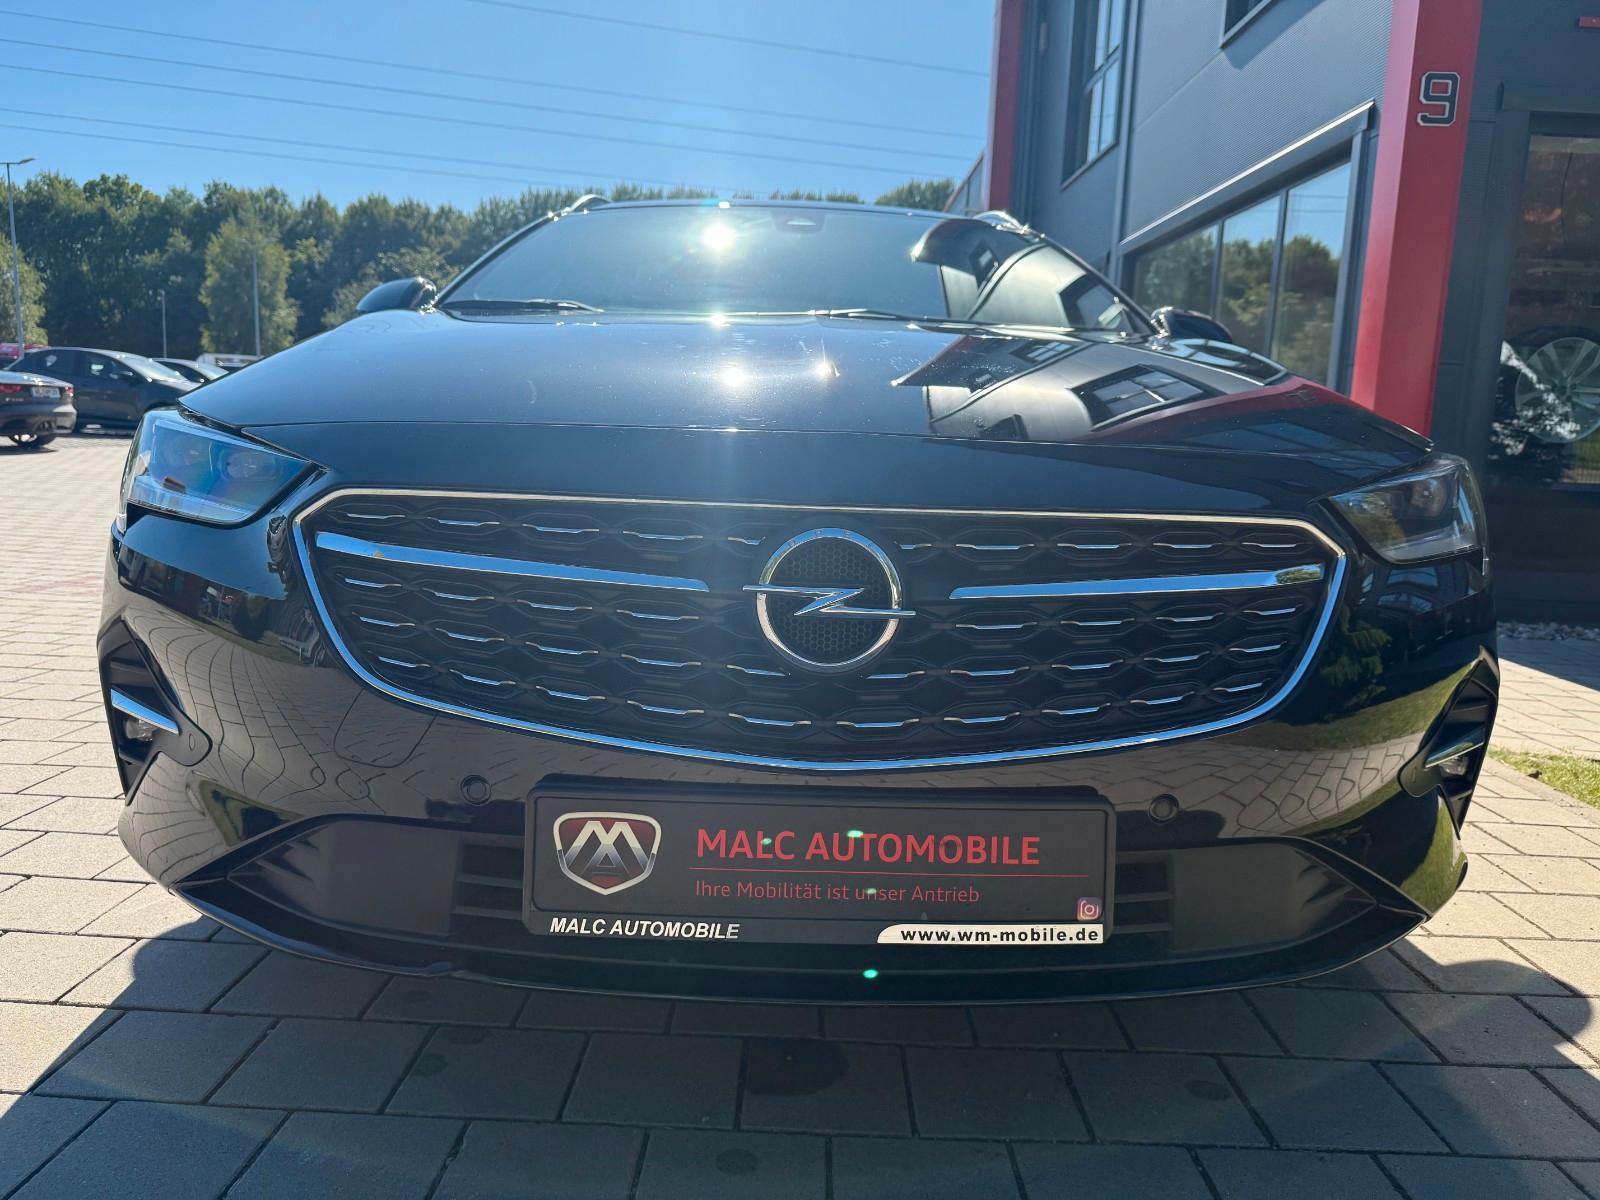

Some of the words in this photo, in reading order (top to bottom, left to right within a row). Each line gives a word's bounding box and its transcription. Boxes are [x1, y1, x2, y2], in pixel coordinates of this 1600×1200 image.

[1417, 71, 1461, 126] 9
[697, 828, 795, 860] MALC
[805, 831, 1041, 865] AUTOMOBILE
[695, 880, 731, 897] Ihre
[737, 881, 822, 899] Mobilität
[827, 883, 849, 900] ist
[855, 887, 907, 902] unser
[911, 885, 980, 903] Antrieb
[550, 917, 607, 935] MALC
[609, 919, 741, 939] AUTOMOBILE
[901, 927, 1099, 942] www.wm-mobile.de
